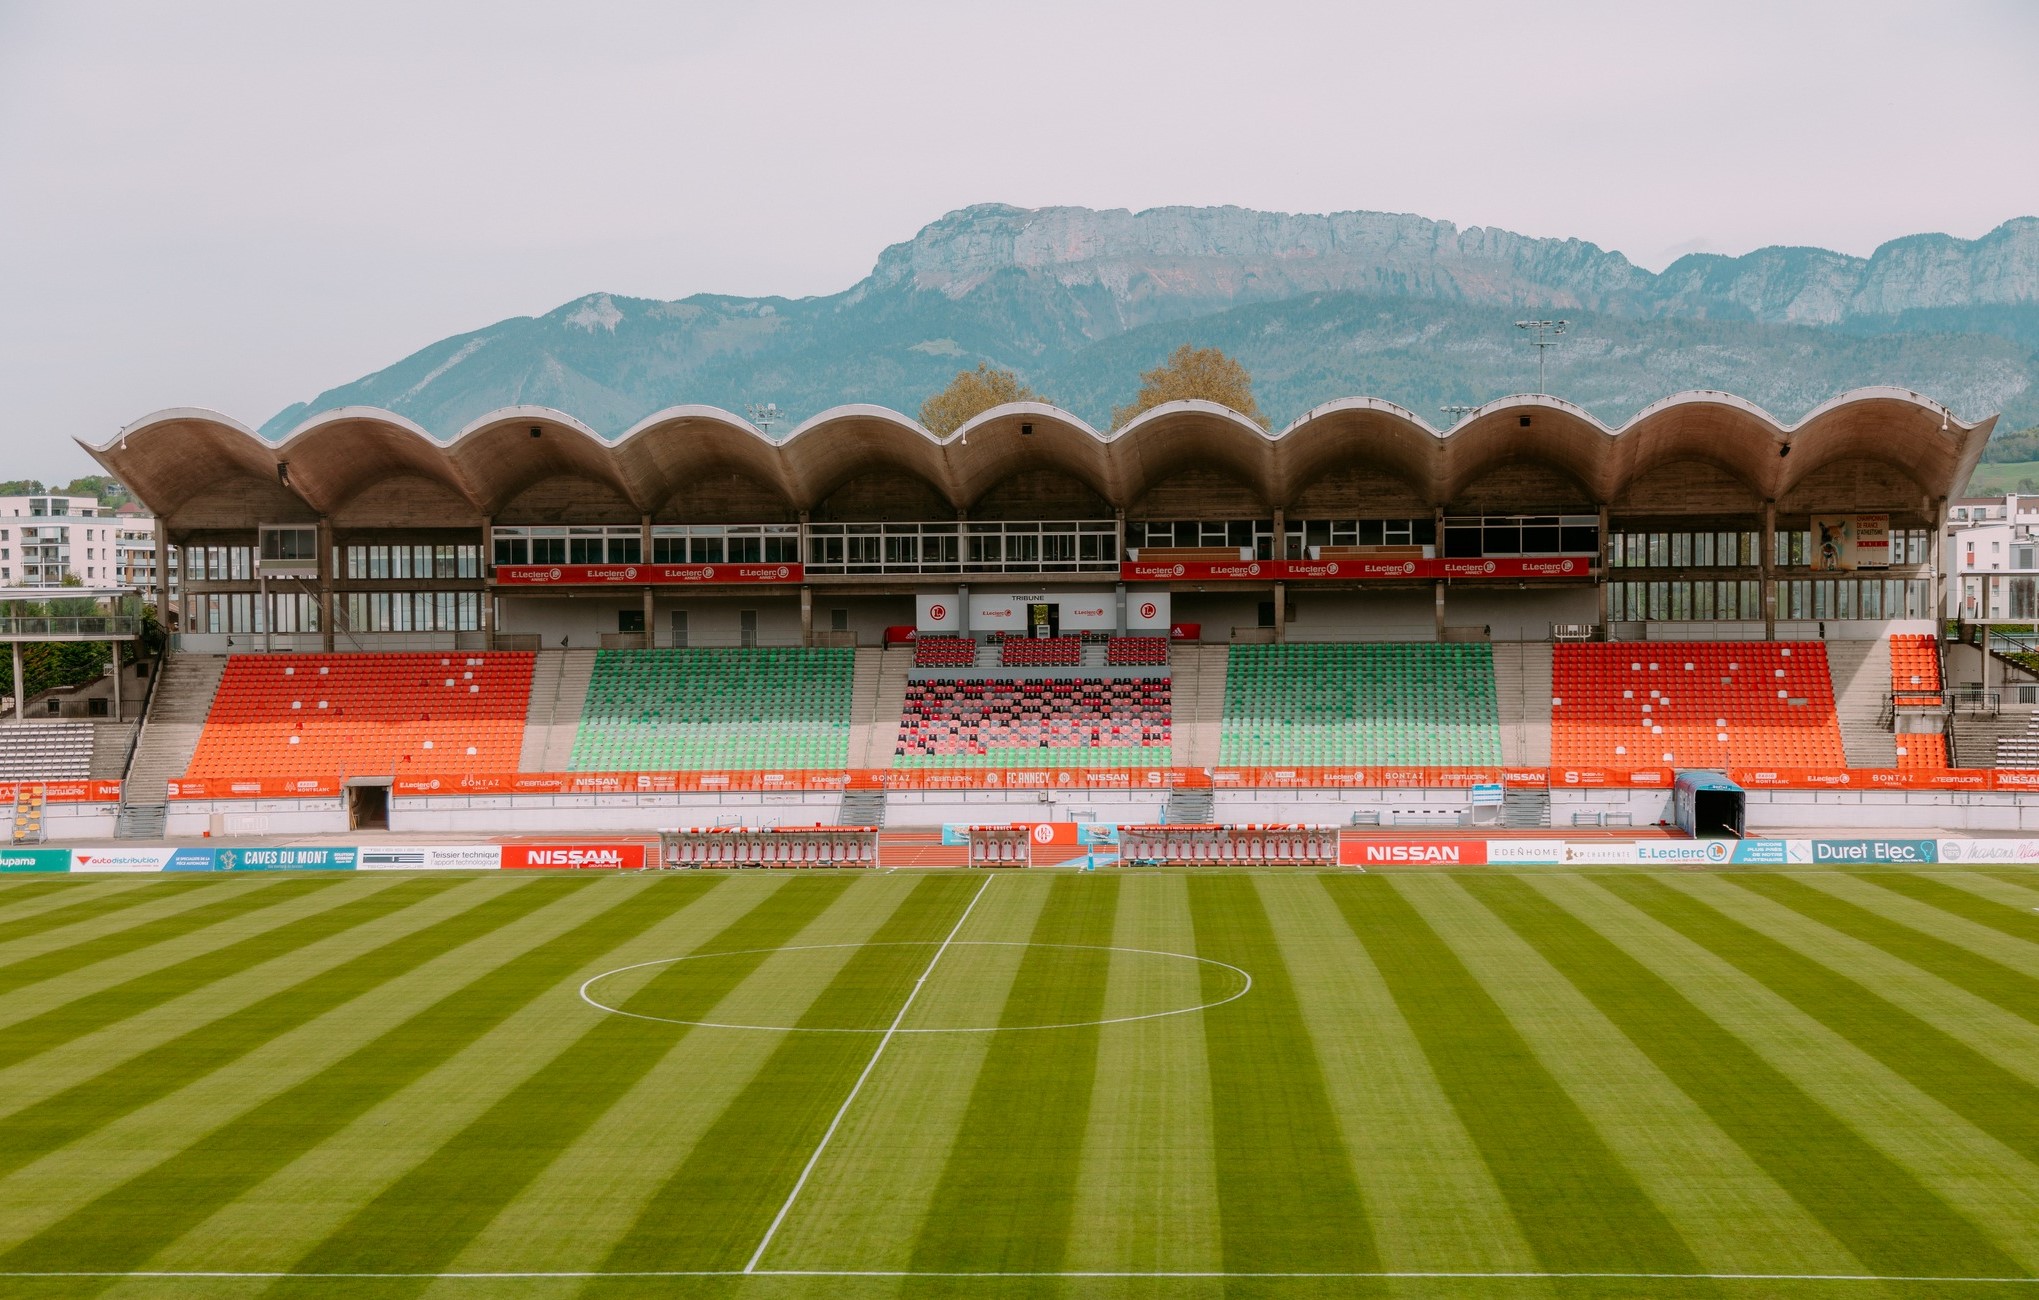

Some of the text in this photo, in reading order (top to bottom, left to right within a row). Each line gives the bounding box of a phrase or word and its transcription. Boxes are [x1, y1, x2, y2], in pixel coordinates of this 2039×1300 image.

[1210, 566, 1248, 574] E.Leclerc
[1522, 563, 1561, 571] E.Leclerc
[1006, 771, 1050, 784] FC ANNECY
[1501, 773, 1545, 781] NISSAN
[1872, 774, 1914, 782] BONTAZ
[1999, 775, 2039, 784] NISSA
[1367, 846, 1460, 861] NISSAN
[1638, 848, 1705, 859] E.Leclerc
[1818, 842, 1915, 859] Duret Elec
[91, 856, 159, 864] autodistribution
[244, 851, 329, 865] CAVES DU MONT
[462, 851, 500, 860] technique
[528, 850, 618, 865] NISSAN
